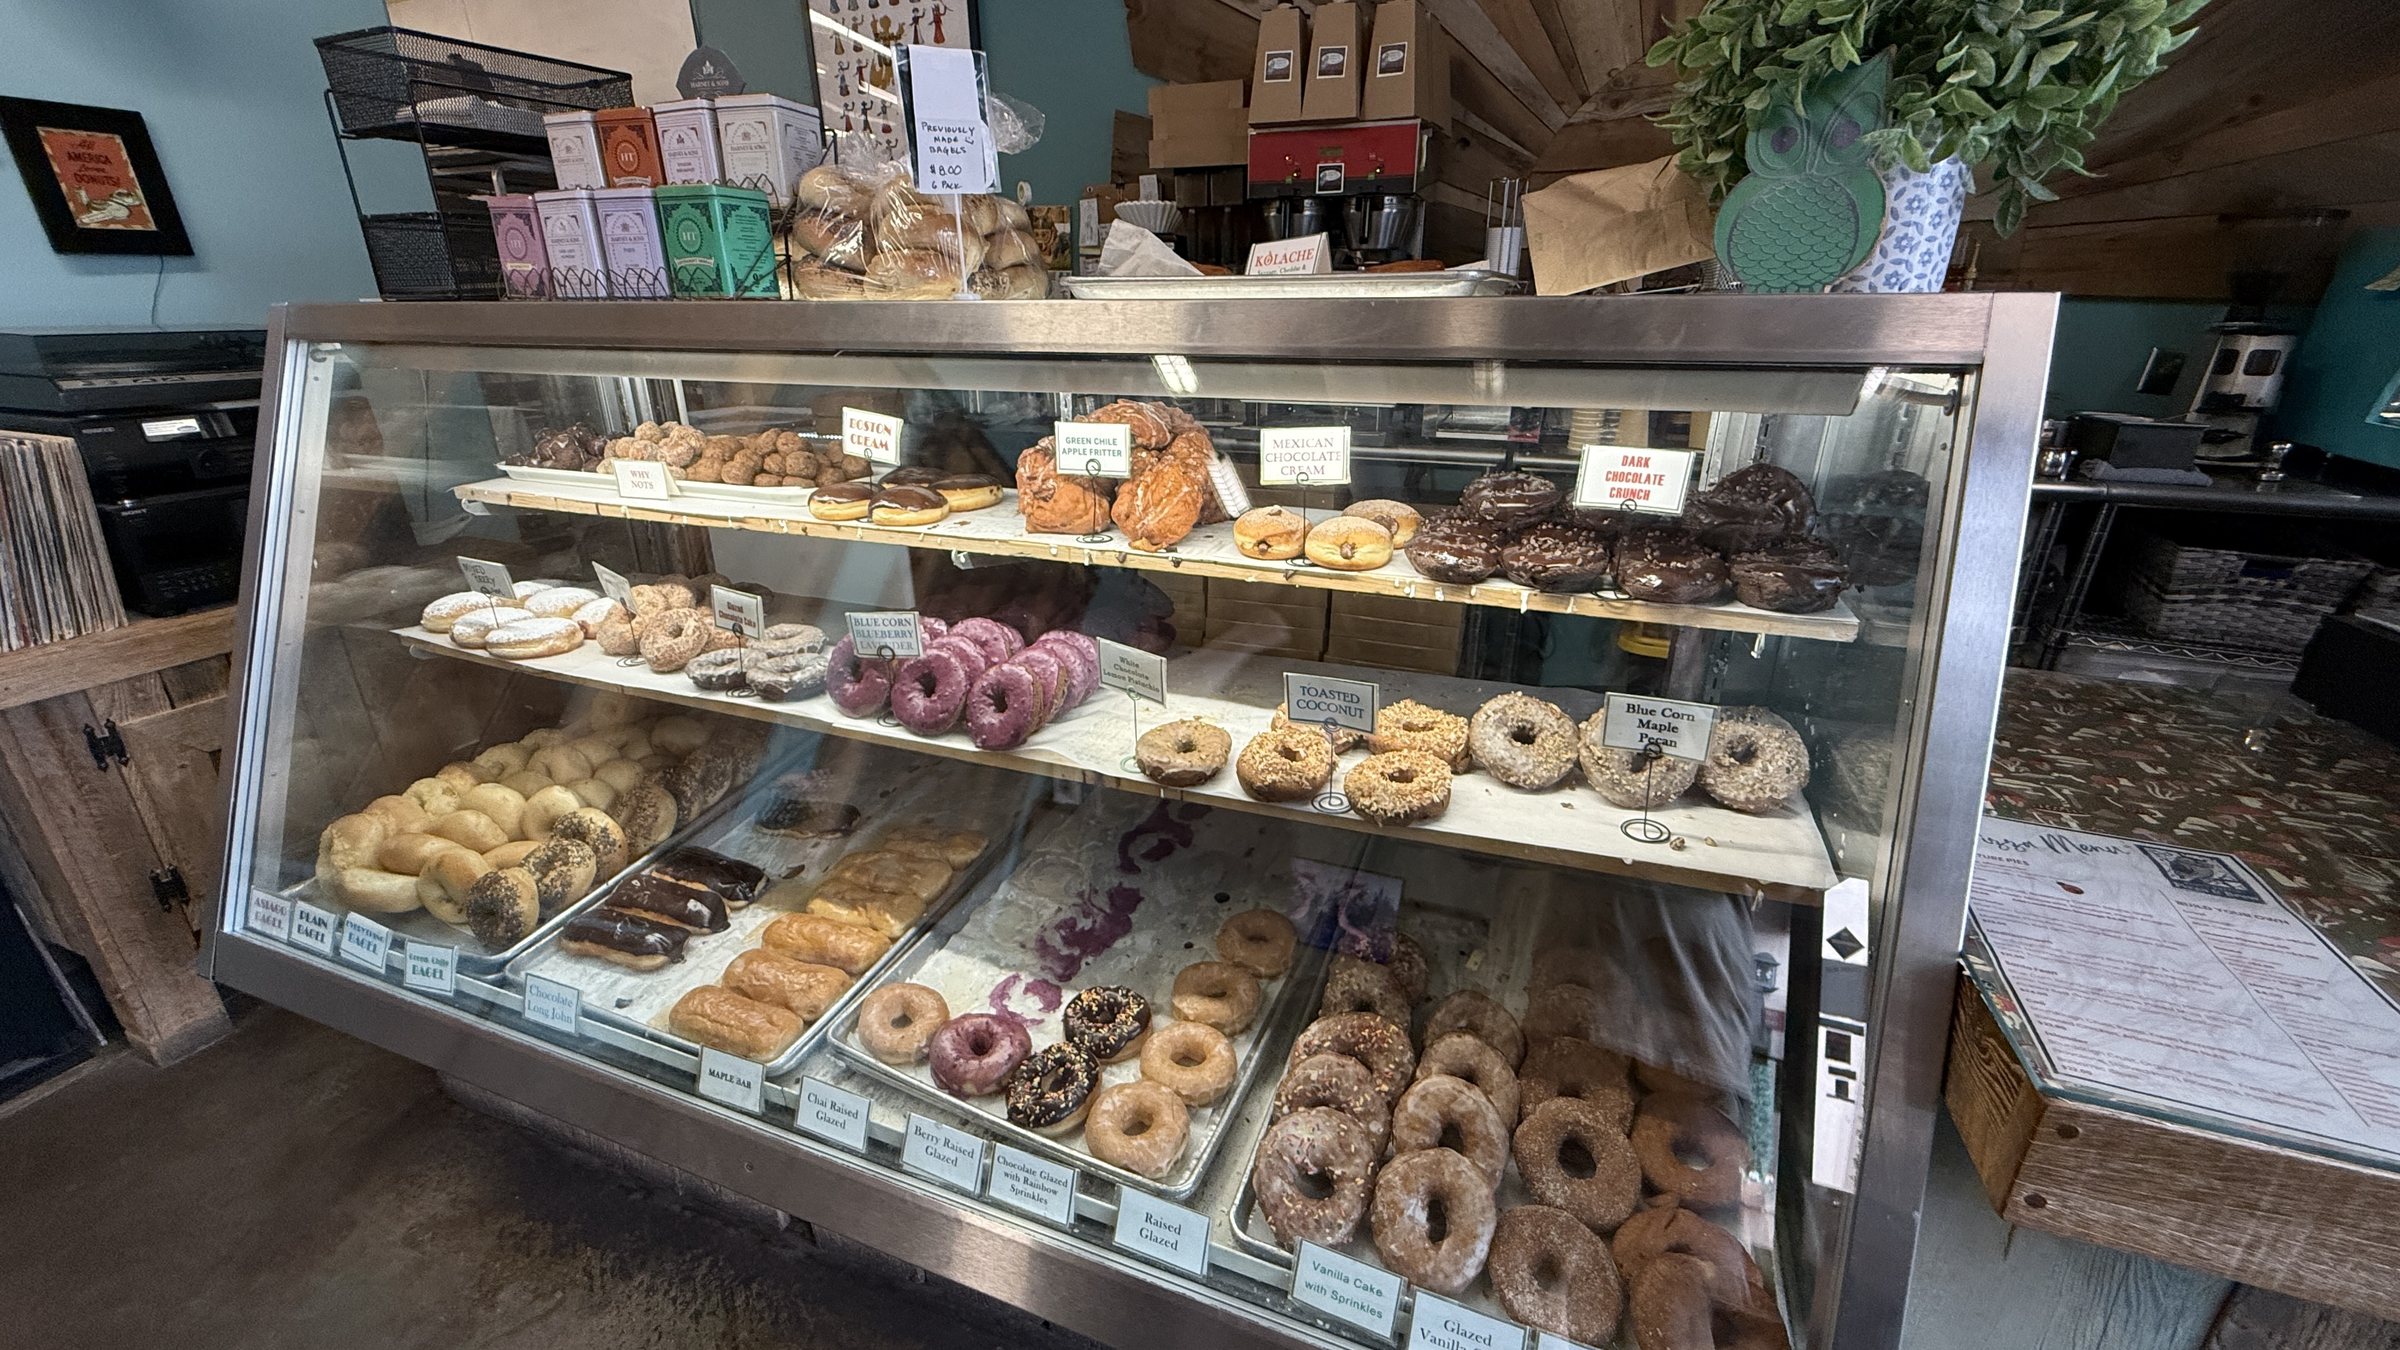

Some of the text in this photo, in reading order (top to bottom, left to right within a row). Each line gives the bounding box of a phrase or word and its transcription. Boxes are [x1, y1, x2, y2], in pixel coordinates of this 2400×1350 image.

[922, 121, 975, 136] PREVIOUSLY
[67, 151, 112, 165] AMERICA
[929, 146, 967, 156] BAGELS
[930, 164, 962, 176] $8.00
[932, 181, 962, 190] 6 PACK
[849, 418, 892, 436] BOSTON
[850, 433, 889, 451] CREAM
[1065, 436, 1118, 446] GREEN CHILE
[1272, 437, 1334, 449] MEXICAN
[1062, 448, 1122, 457] APPLE FRITTER
[1265, 452, 1341, 463] CHOCOLATE
[1621, 455, 1651, 468] DARK
[630, 470, 650, 479] WHY
[1280, 465, 1325, 476] CREAM
[1604, 470, 1666, 486] CHOCOLATE
[631, 480, 654, 490] NOTS
[1608, 486, 1652, 501] CRUNCH
[854, 616, 912, 627] BLUE CORN
[856, 630, 914, 639] BLUEBERRY
[1119, 656, 1140, 668] White
[1103, 668, 1127, 682] Lemon
[1113, 663, 1150, 680] Chocolate
[1300, 686, 1360, 704] TOASTED
[1296, 698, 1365, 720] COCONUT
[1626, 702, 1696, 722] Blue Corn
[1636, 718, 1679, 734] Maple
[1638, 732, 1678, 748] Pecan
[1979, 834, 2128, 856] izza Menu
[254, 897, 288, 916] ASIAGO
[254, 911, 284, 930] BAGEL
[300, 910, 328, 930] PLAIN
[297, 924, 326, 944] BAGEL
[345, 920, 385, 942] EVERYTHING
[348, 932, 378, 956] BAGEL
[412, 964, 445, 980] BAGEL
[529, 984, 574, 1008] Chocolate
[528, 1000, 573, 1024] Long John
[708, 1068, 752, 1090] MAPLE BAR
[807, 1092, 859, 1120] Chai Raised
[816, 1110, 846, 1130] Glazed
[914, 1125, 975, 1159] Berry Raised
[925, 1145, 958, 1168] Glazed
[996, 1155, 1068, 1188] Chocolate Glazed
[1004, 1170, 1059, 1196] with Rainbow
[1010, 1183, 1048, 1206] Sprinkles
[1144, 1212, 1182, 1236] Raised
[1140, 1227, 1178, 1251] Glazed
[1312, 1260, 1384, 1298] Vanilla Cake
[1304, 1280, 1384, 1320] with Sprinkles
[1444, 1320, 1492, 1347] Glazed
